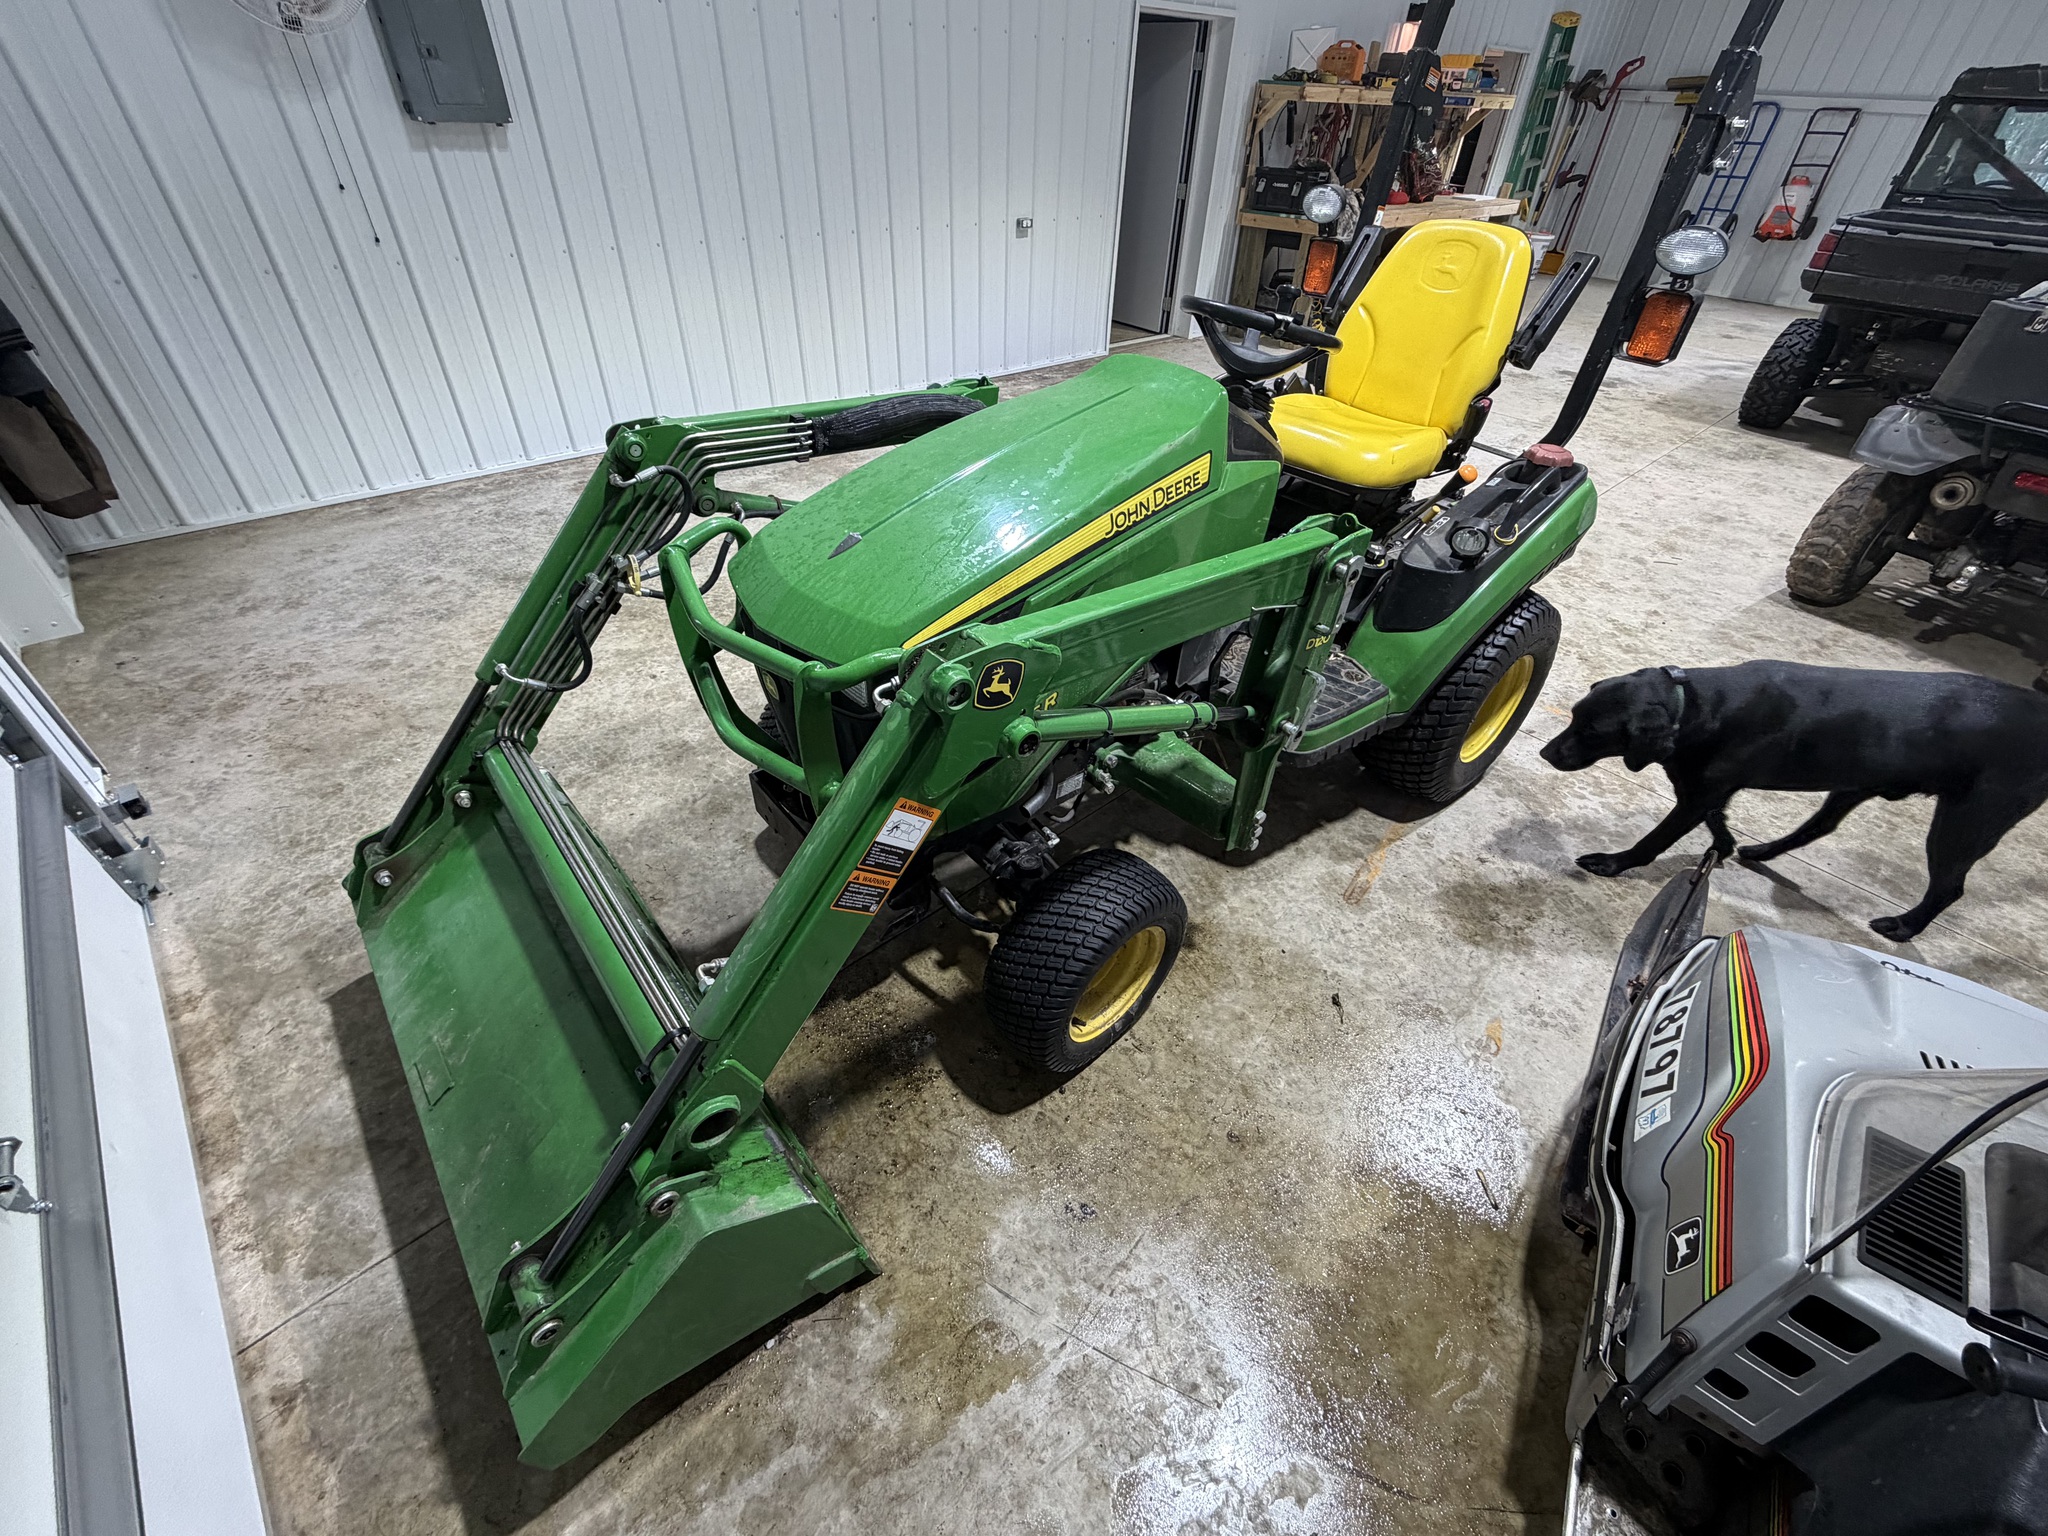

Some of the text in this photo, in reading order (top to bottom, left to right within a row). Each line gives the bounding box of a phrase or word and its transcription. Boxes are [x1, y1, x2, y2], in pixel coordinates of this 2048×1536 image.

[1933, 274, 2021, 293] POLARIS
[1105, 471, 1201, 536] JOHN DEERE
[907, 803, 935, 818] WARNING
[861, 875, 891, 887] WARNING
[1640, 985, 1697, 1099] 78797
